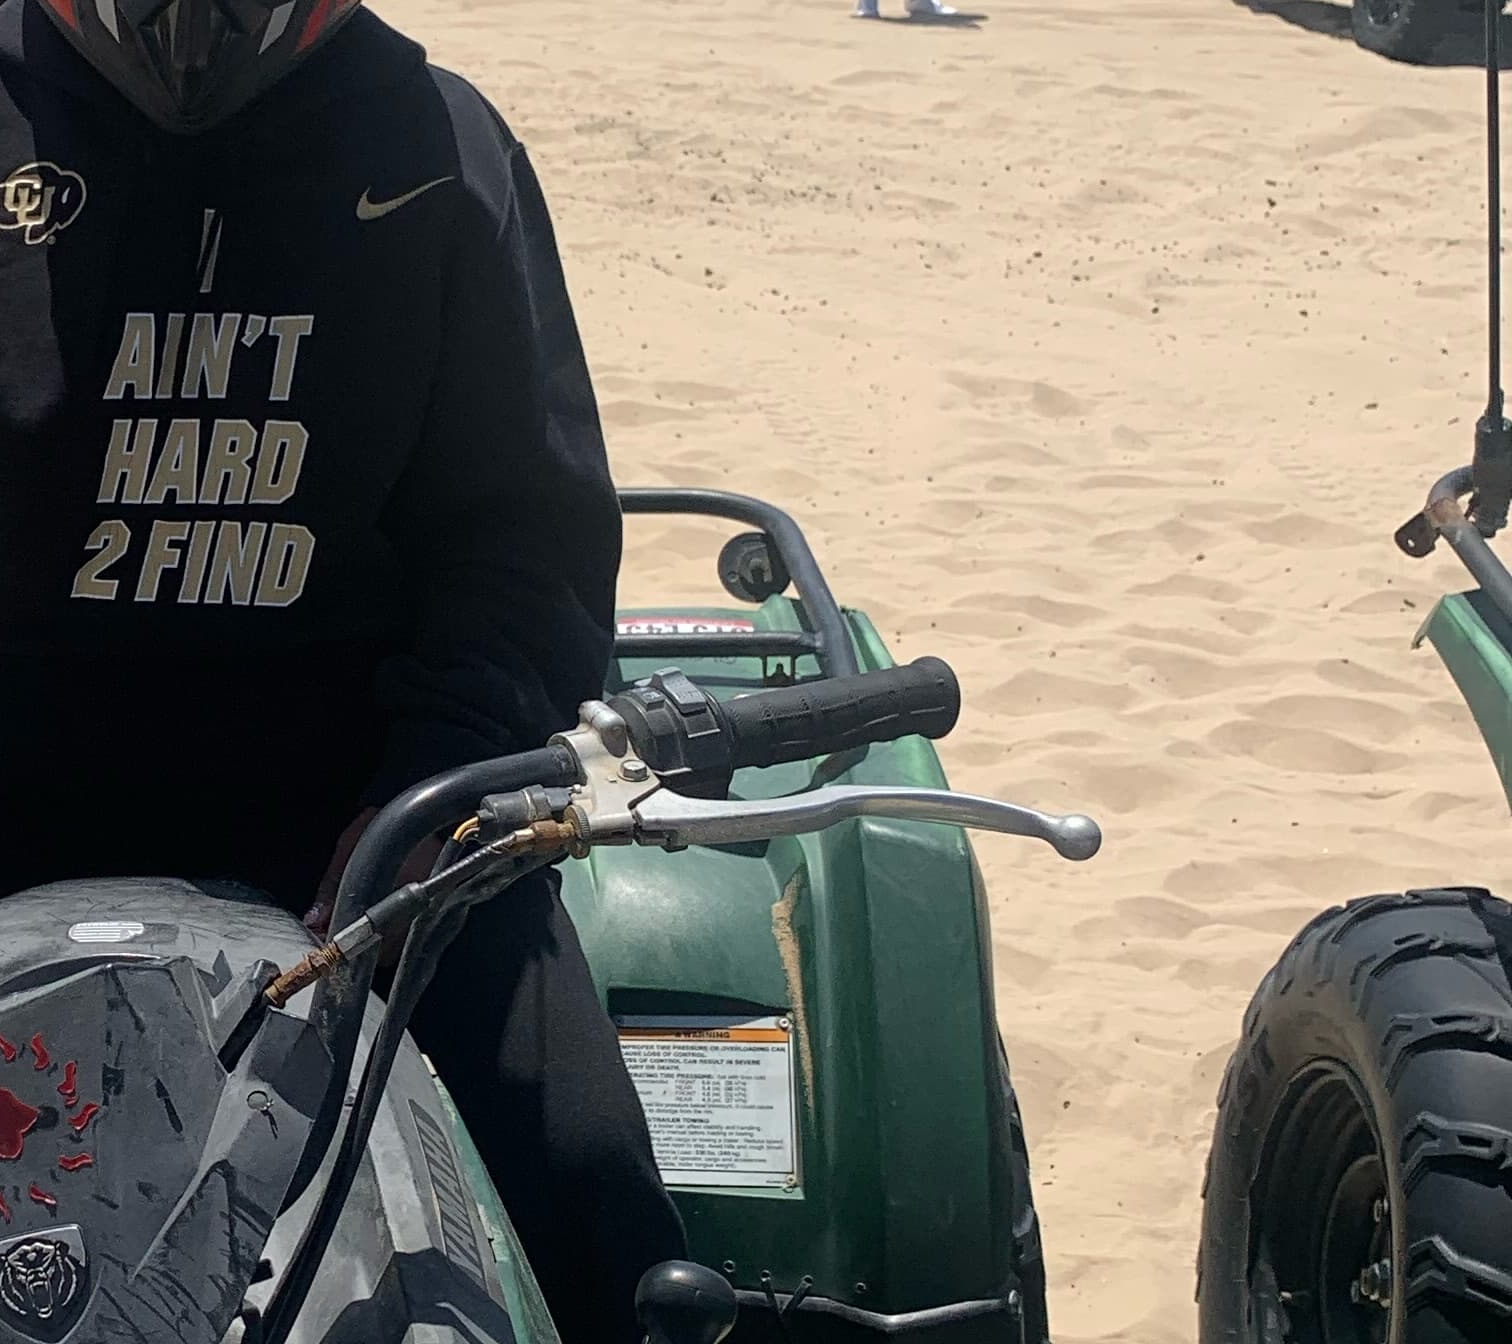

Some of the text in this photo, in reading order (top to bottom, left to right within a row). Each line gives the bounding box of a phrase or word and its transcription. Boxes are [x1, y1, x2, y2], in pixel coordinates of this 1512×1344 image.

[4, 174, 55, 225] CU
[197, 208, 223, 293] I
[103, 312, 314, 400] AIN'T
[96, 418, 309, 504] HARD
[70, 519, 316, 607] 2 FIND
[416, 1116, 483, 1279] YAMAHA
